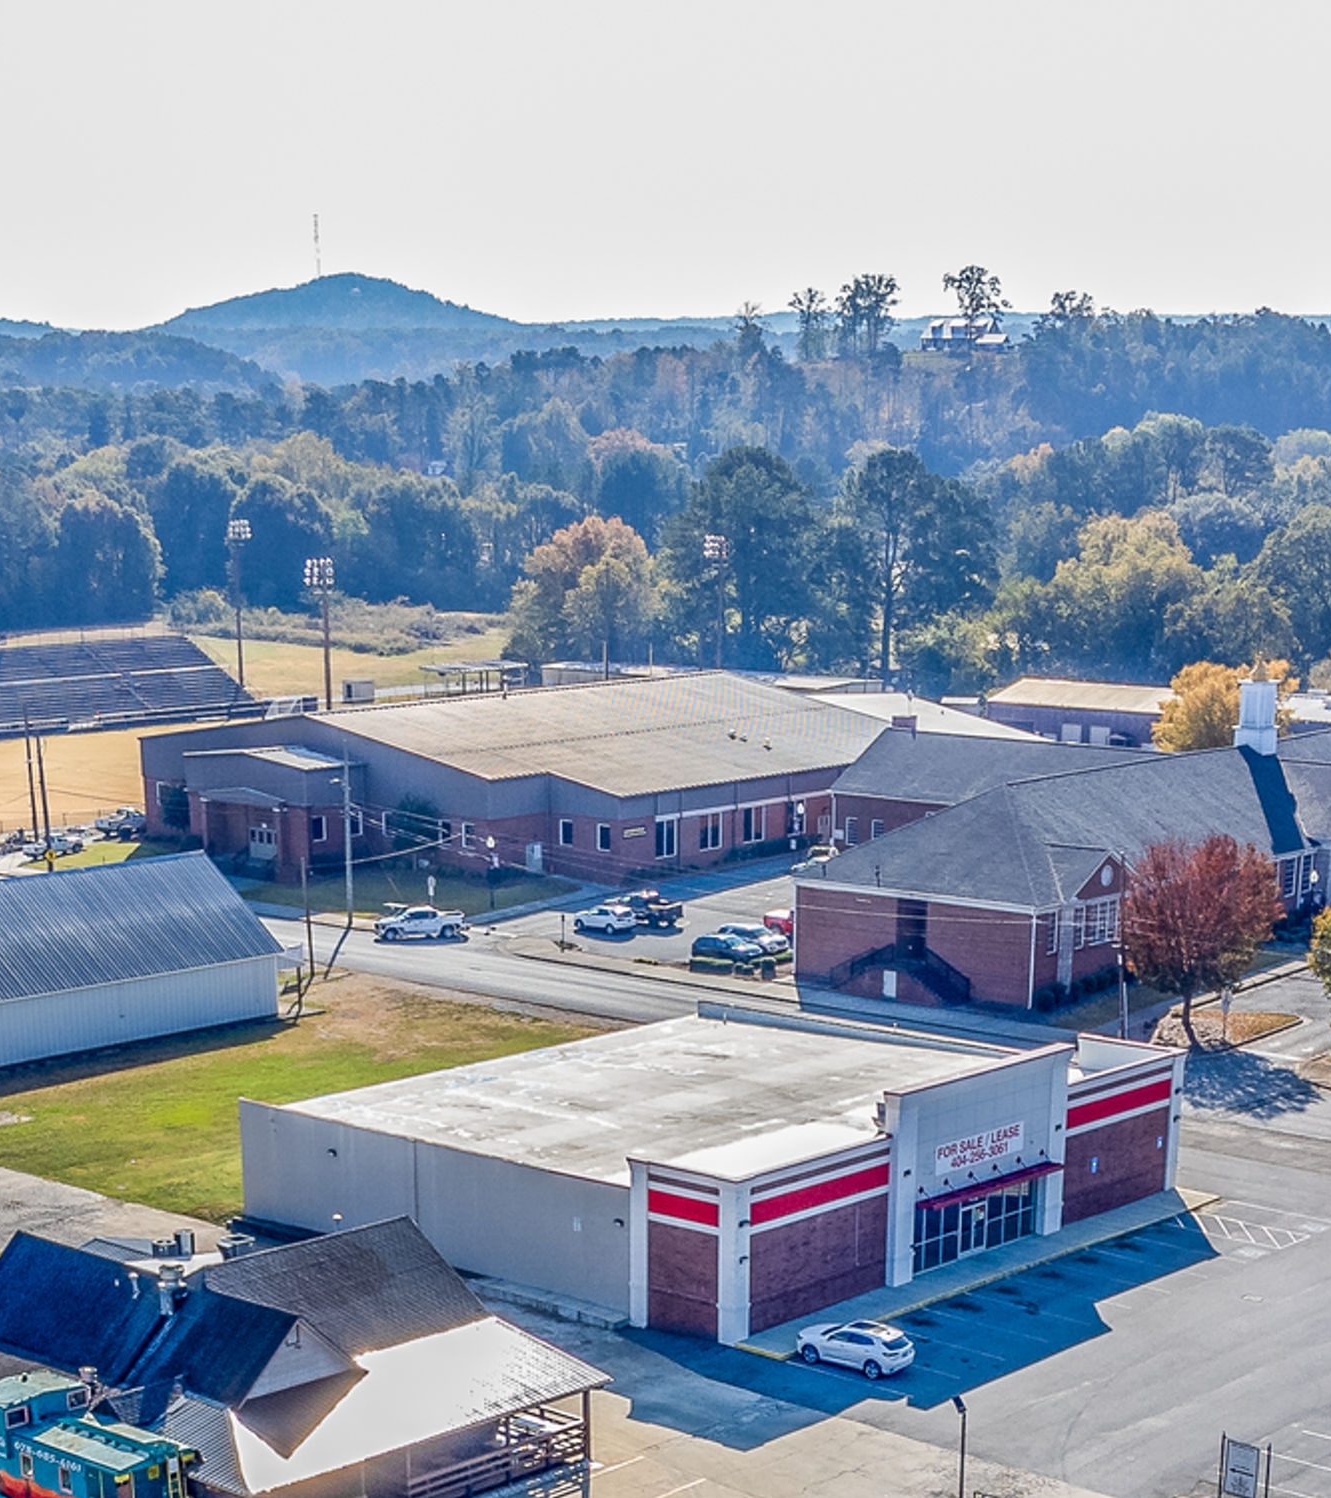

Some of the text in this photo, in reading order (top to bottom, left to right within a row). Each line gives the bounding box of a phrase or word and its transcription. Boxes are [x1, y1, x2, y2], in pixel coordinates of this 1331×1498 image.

[937, 1143, 958, 1160] FOR
[959, 1135, 984, 1154] SALE
[990, 1124, 1020, 1144] LEASE
